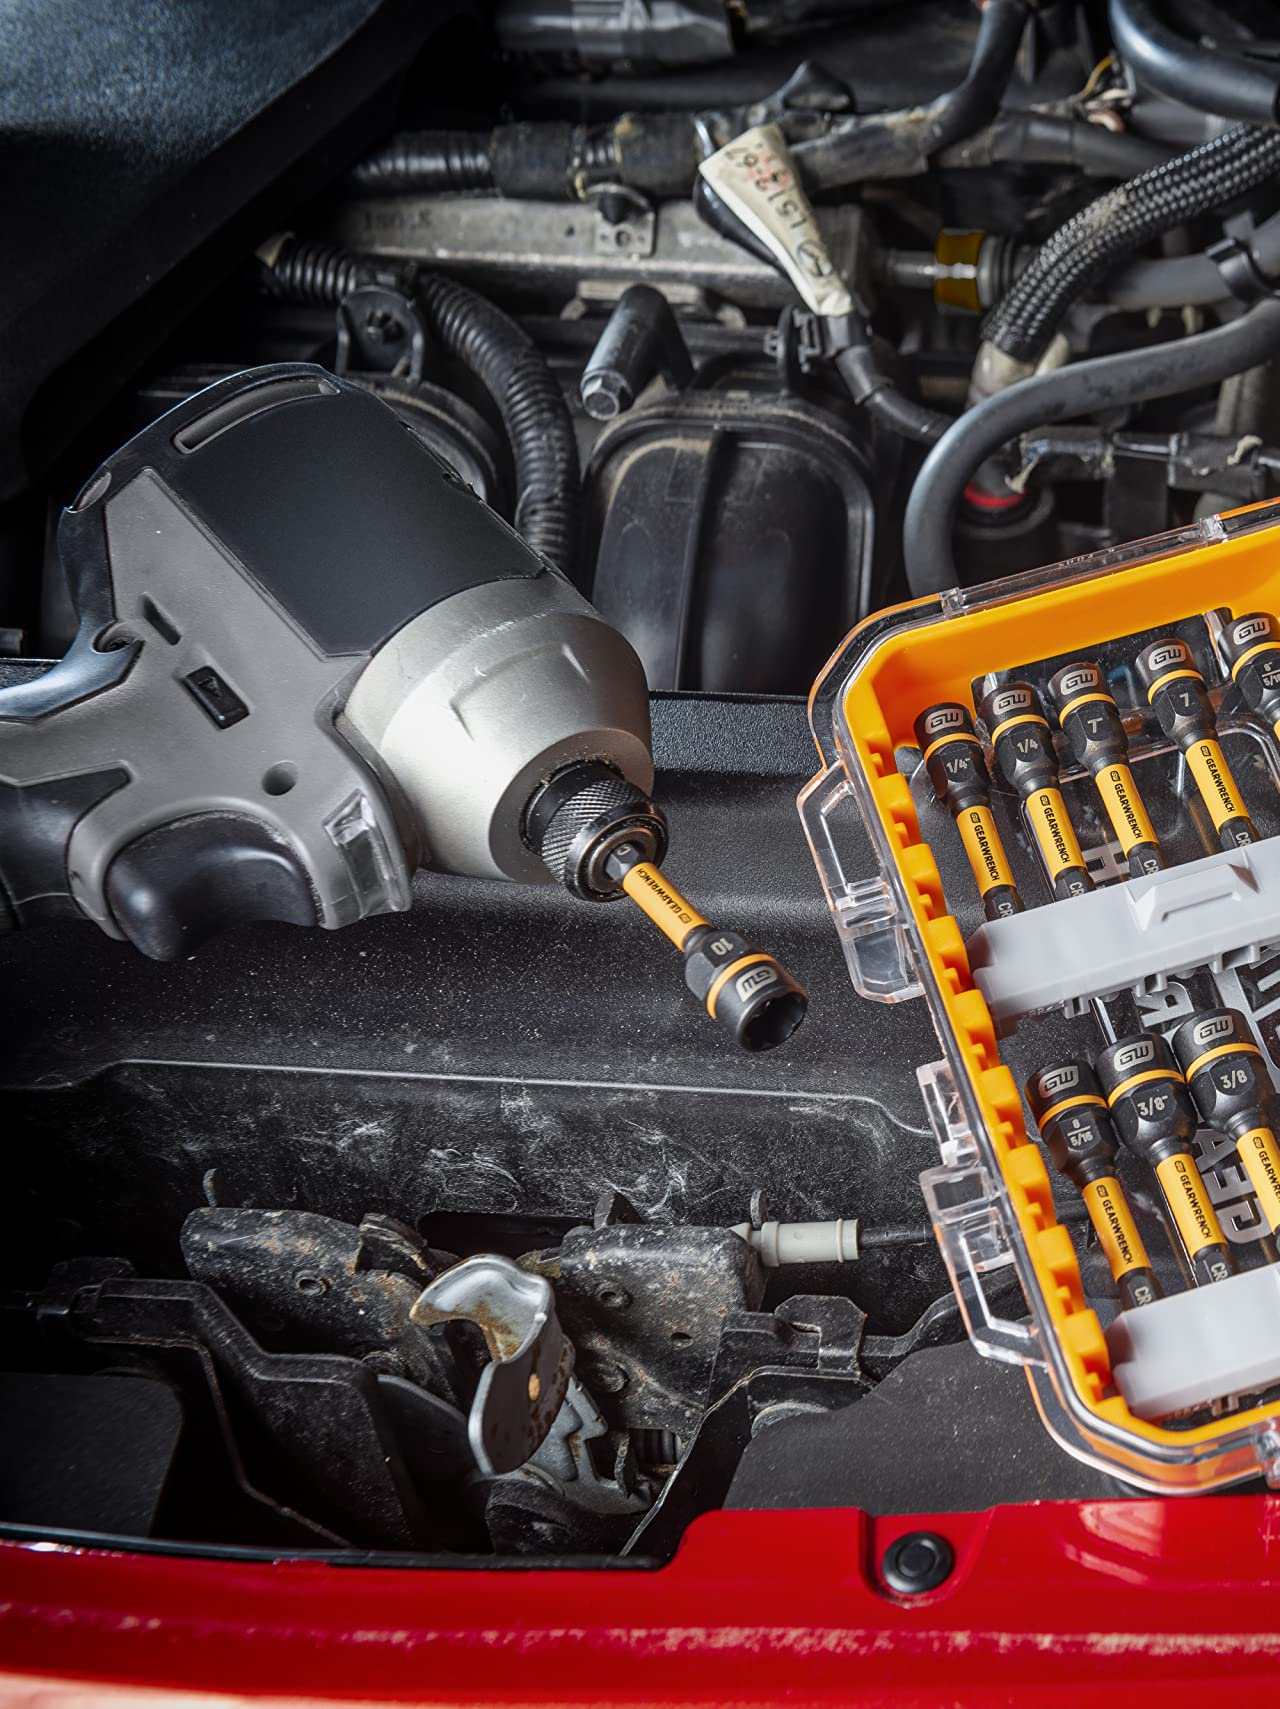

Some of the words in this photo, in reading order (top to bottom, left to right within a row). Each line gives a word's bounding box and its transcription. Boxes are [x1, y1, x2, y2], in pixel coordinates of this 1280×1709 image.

[1115, 783, 1143, 839] GEARWRENCH
[1205, 758, 1235, 813] GEARWRENCH
[974, 824, 1000, 881] GEARWRENCH
[1044, 807, 1069, 864] GEARWRENCH
[636, 868, 682, 914] GEARWRENCH
[711, 938, 734, 955] 10
[1220, 1069, 1248, 1089] 3/8
[1069, 1131, 1093, 1146] 5/16
[1071, 1119, 1080, 1128] 8
[1102, 1199, 1133, 1264] GEARWRENCH
[1180, 1175, 1211, 1239] GEARWRENCH
